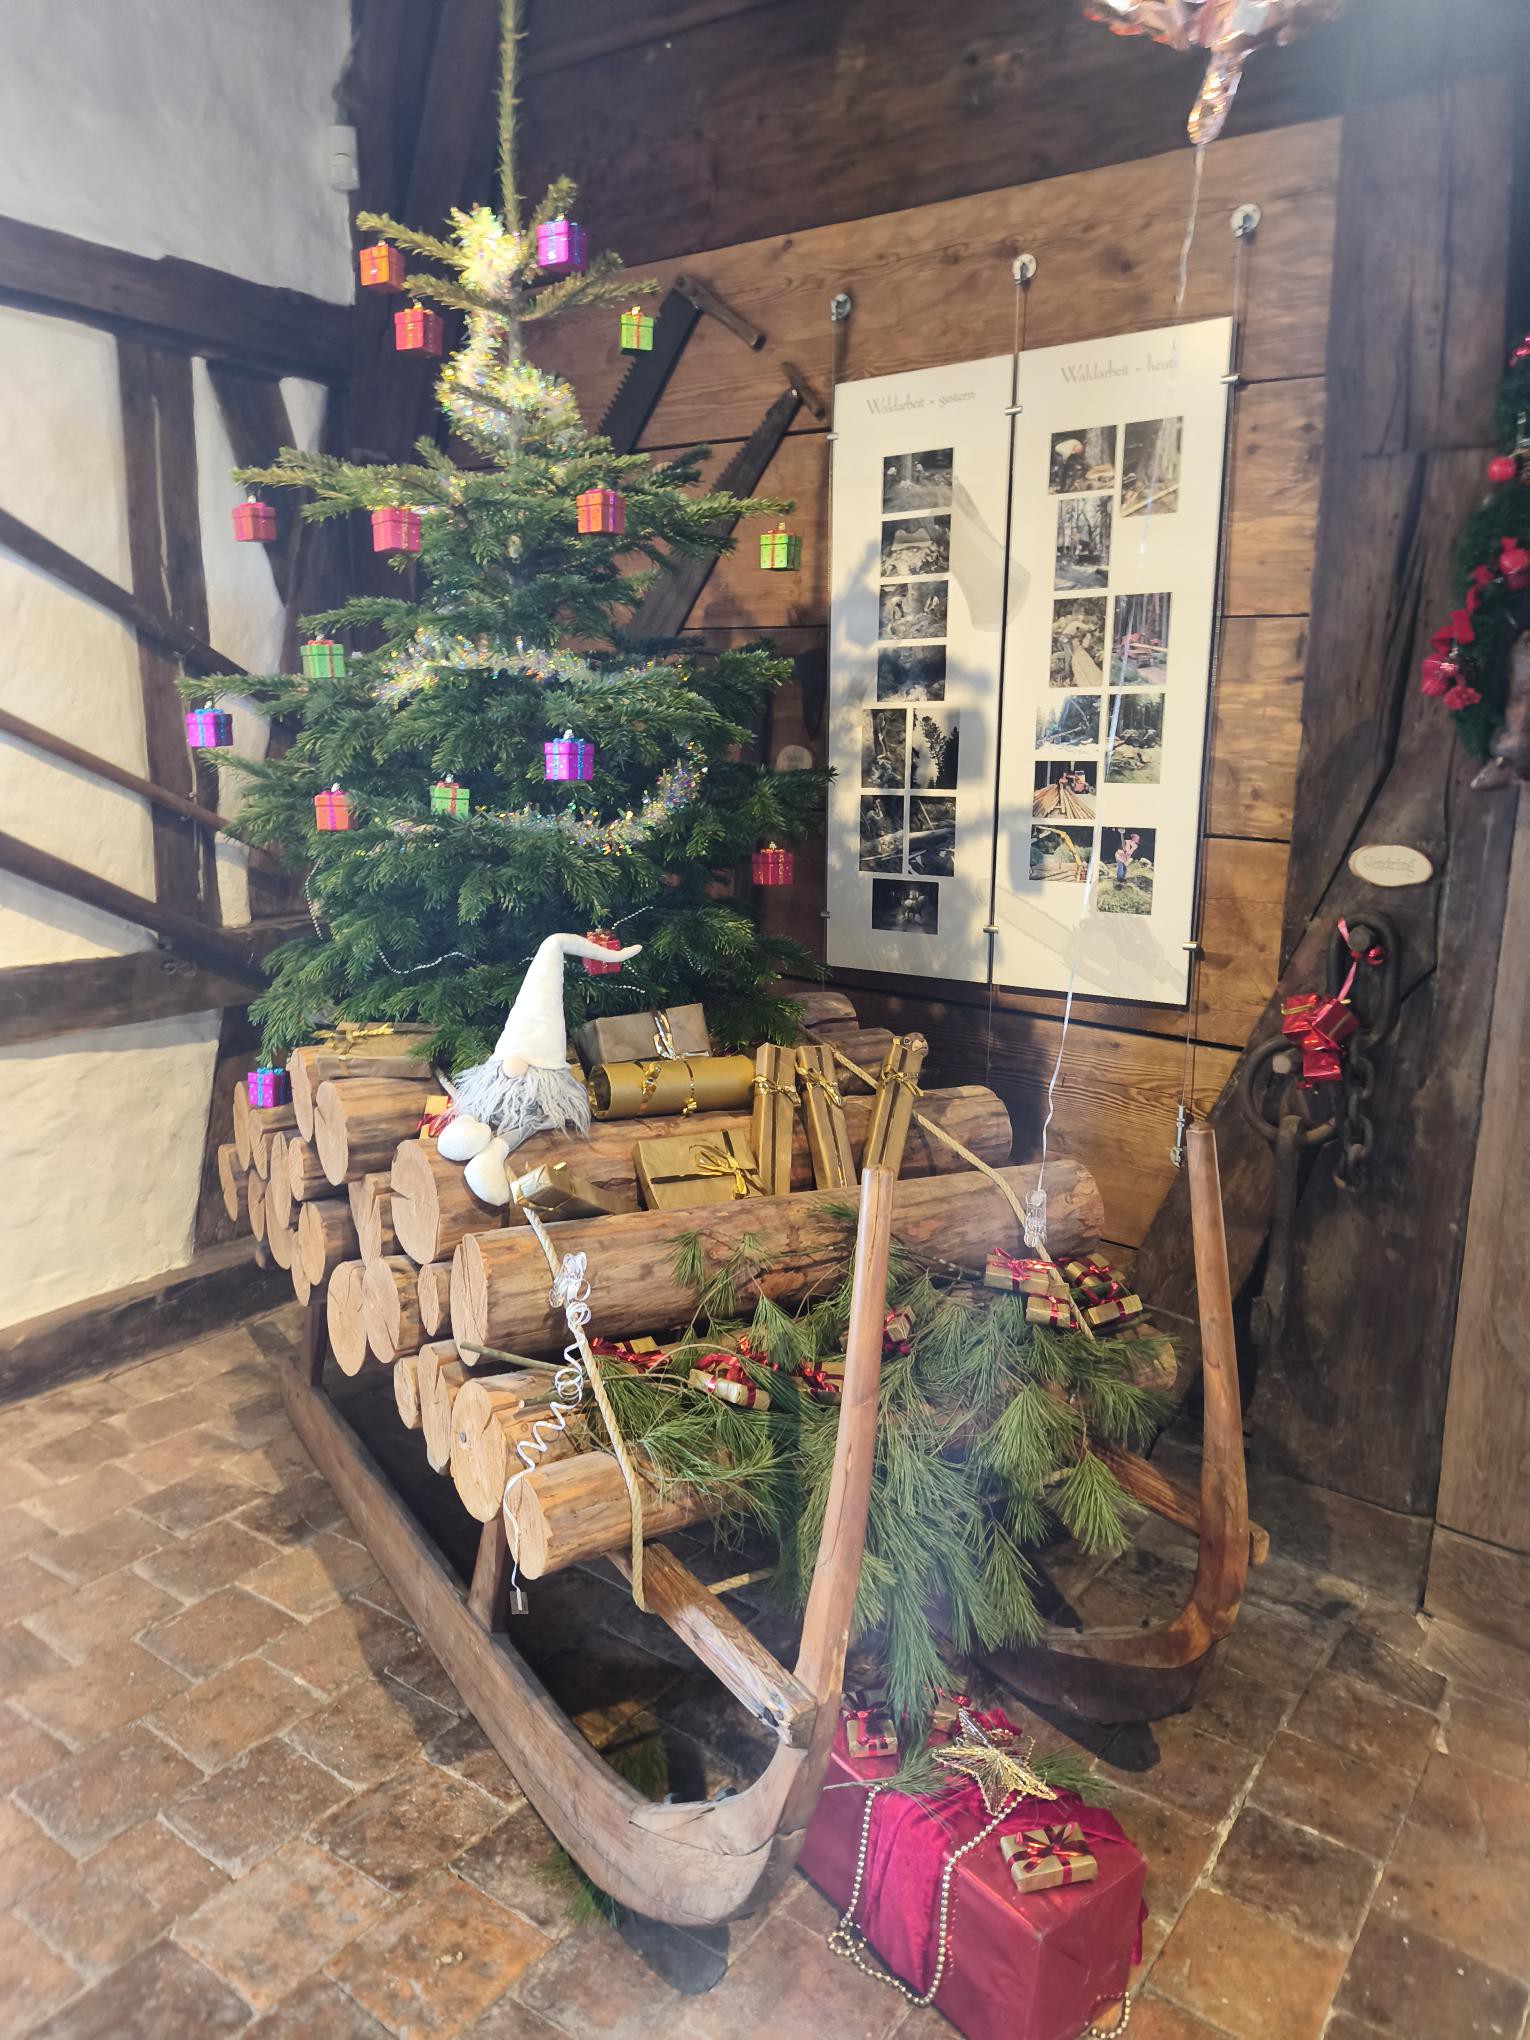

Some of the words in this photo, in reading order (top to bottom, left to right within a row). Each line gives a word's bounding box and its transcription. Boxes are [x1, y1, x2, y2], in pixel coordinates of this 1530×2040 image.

[1060, 359, 1128, 384] Waldarbeit
[865, 392, 925, 415] Waldarbeit
[938, 391, 976, 409] gestern
